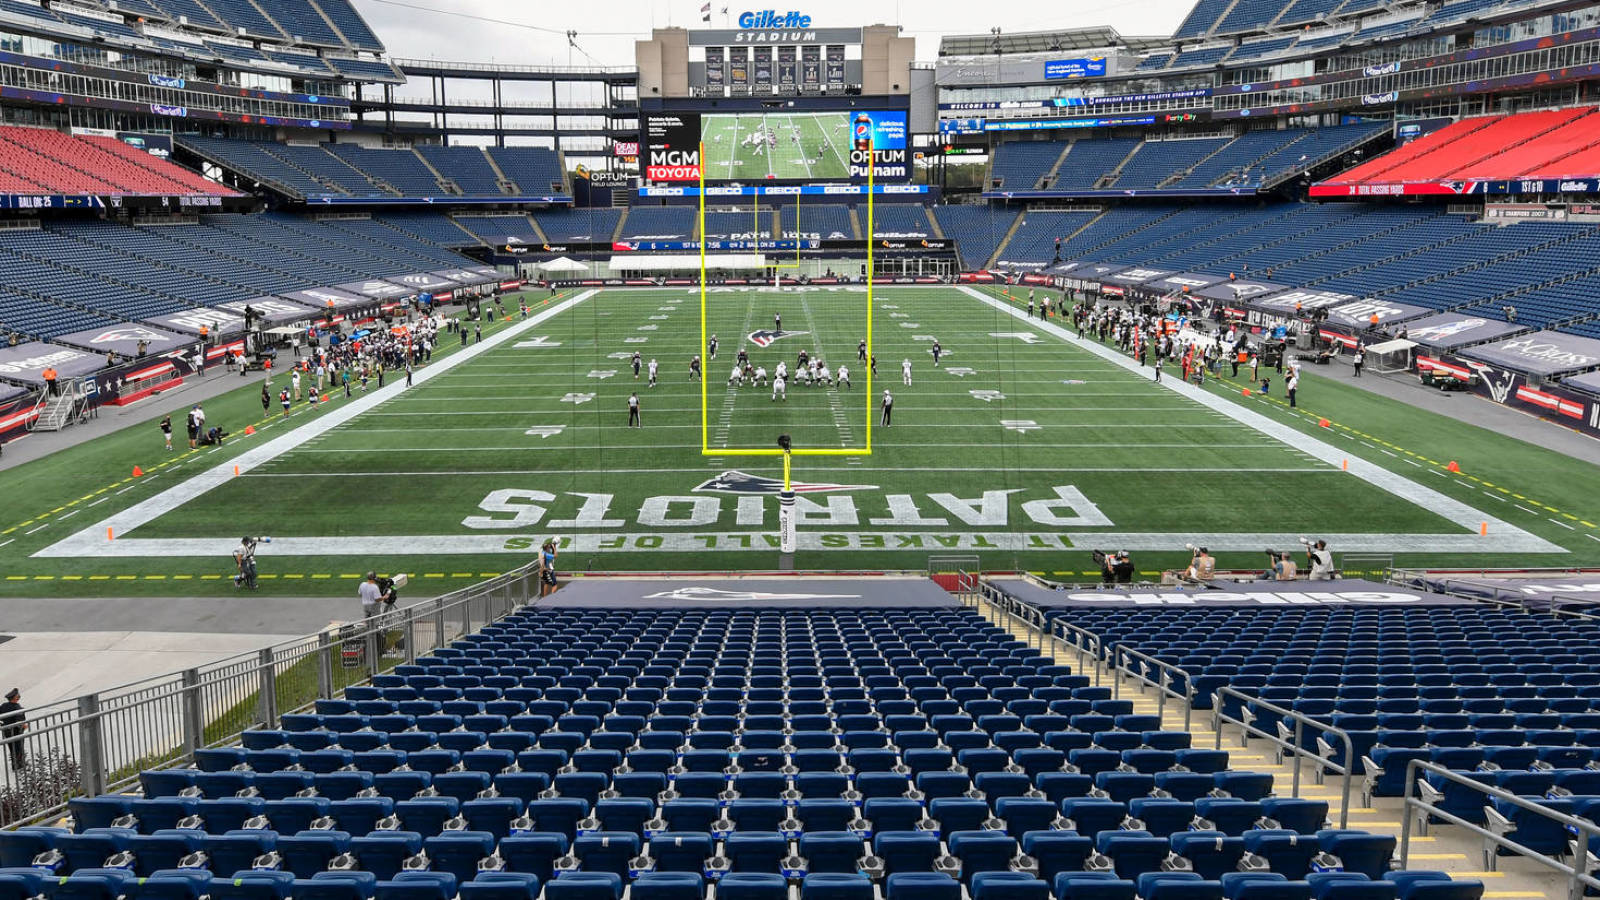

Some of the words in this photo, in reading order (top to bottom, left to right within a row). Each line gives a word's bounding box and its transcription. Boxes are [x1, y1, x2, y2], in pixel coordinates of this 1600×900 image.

[738, 10, 812, 28] Gillette
[735, 32, 816, 42] STADIUM
[616, 142, 638, 150] DEAN
[650, 150, 699, 166] MGM
[649, 168, 700, 178] TOYOTA
[850, 166, 906, 176] Punam
[591, 172, 628, 181] OPTUM
[706, 187, 742, 195] GEICO
[824, 186, 861, 194] GEICO
[1358, 185, 1370, 194] TOTAL
[1371, 185, 1389, 194] PASSING
[1390, 185, 1404, 194] YARDS
[1521, 181, 1531, 192] 1ST
[1536, 181, 1544, 192] 10
[1560, 181, 1588, 191] Gillette
[647, 188, 684, 196] GEICO
[18, 196, 33, 208] BALL
[43, 196, 52, 206] 25
[162, 196, 168, 206] 54
[179, 196, 191, 206] TOTAL
[191, 196, 209, 206] PASSING
[209, 196, 222, 206] YARDS
[460, 484, 1116, 529] PATRIOTS
[504, 536, 573, 550] US
[598, 536, 665, 549] OF
[694, 534, 781, 549] ALL
[820, 534, 998, 548] TAKES
[1026, 534, 1076, 548] IT
[1067, 580, 1424, 598] Gillette
